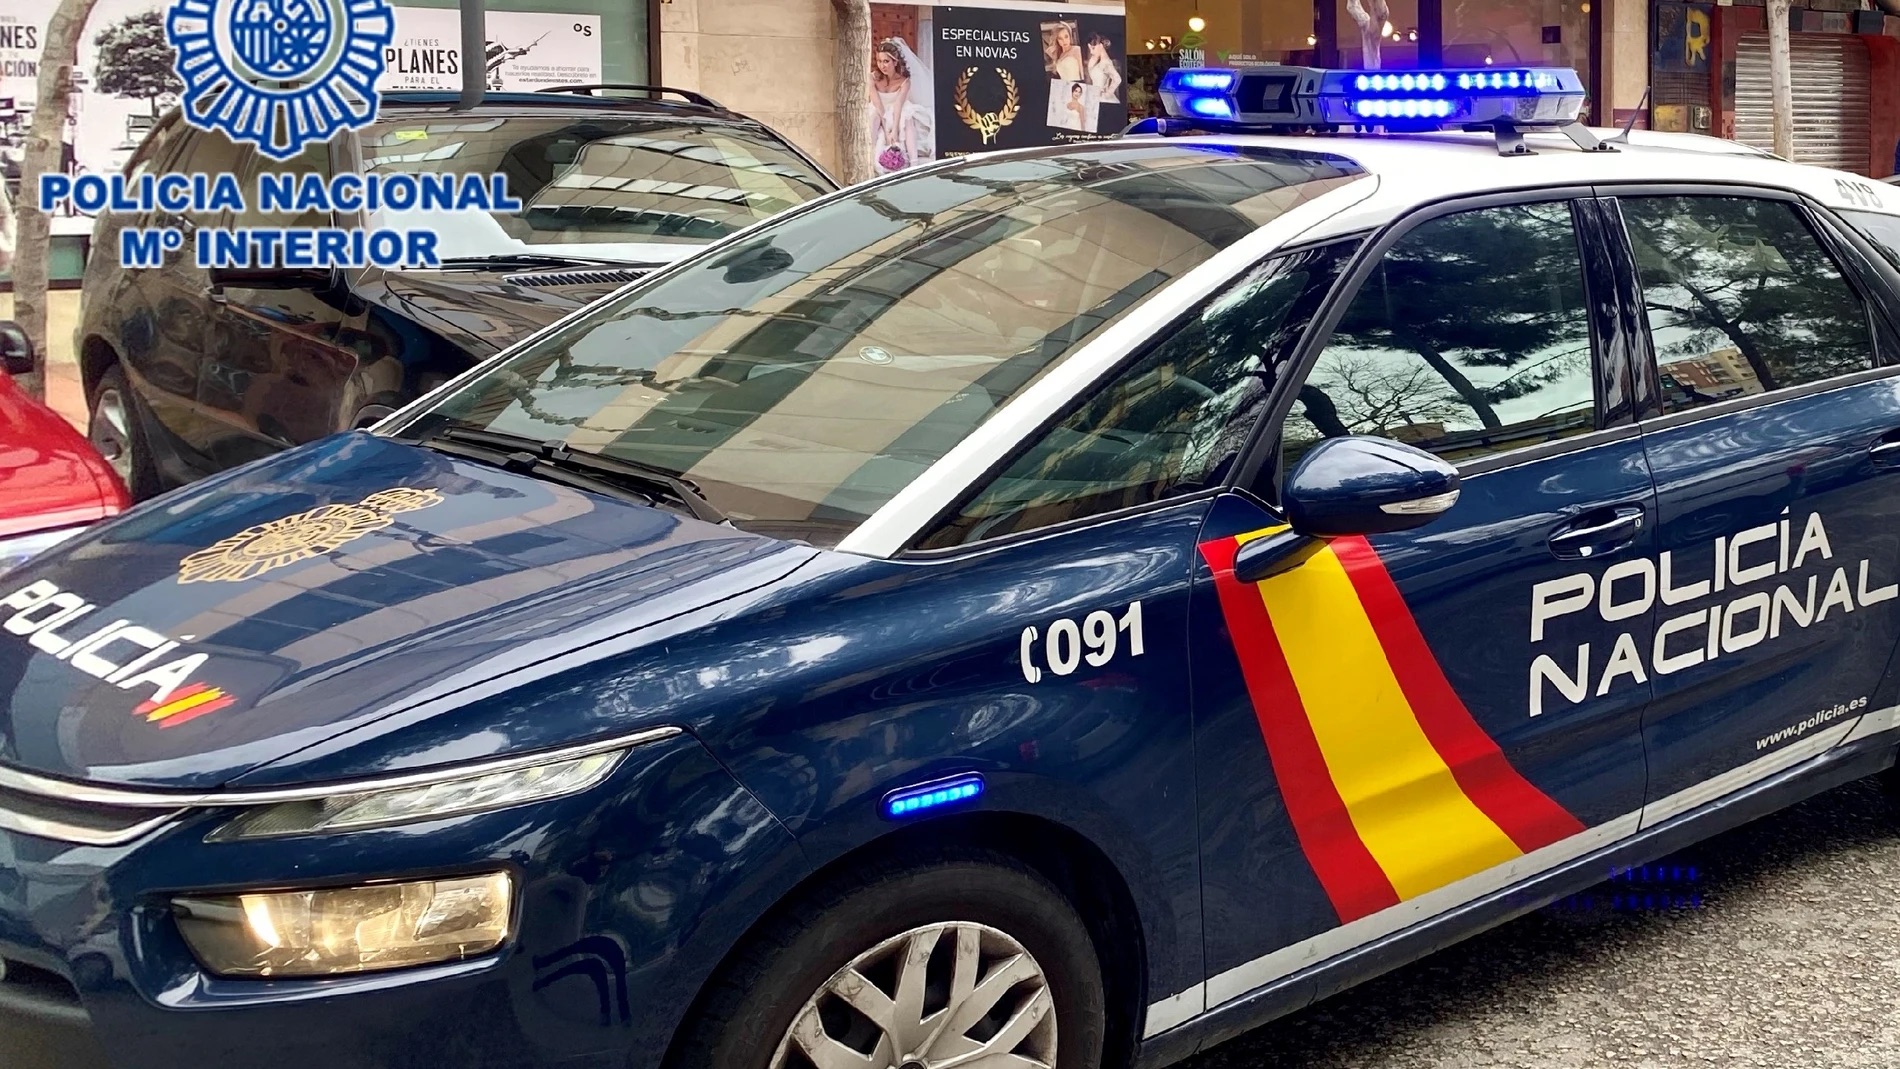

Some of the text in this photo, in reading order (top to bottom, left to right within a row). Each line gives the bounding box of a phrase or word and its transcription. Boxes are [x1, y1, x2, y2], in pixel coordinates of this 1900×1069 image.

[404, 38, 440, 47] ¿TIENES
[942, 28, 1030, 44] ESPECIALISTAS
[386, 48, 458, 74] PLANES
[956, 45, 1018, 60] EN NOVIAS
[1179, 47, 1205, 60] SALÓN
[405, 76, 441, 85] PARA EL
[1530, 506, 1833, 642] POLICÍA
[0, 579, 209, 704] POLICÍA
[1046, 600, 1144, 676] 091
[1529, 559, 1899, 717] NACIONAL
[1755, 695, 1867, 750] www.policia.es
